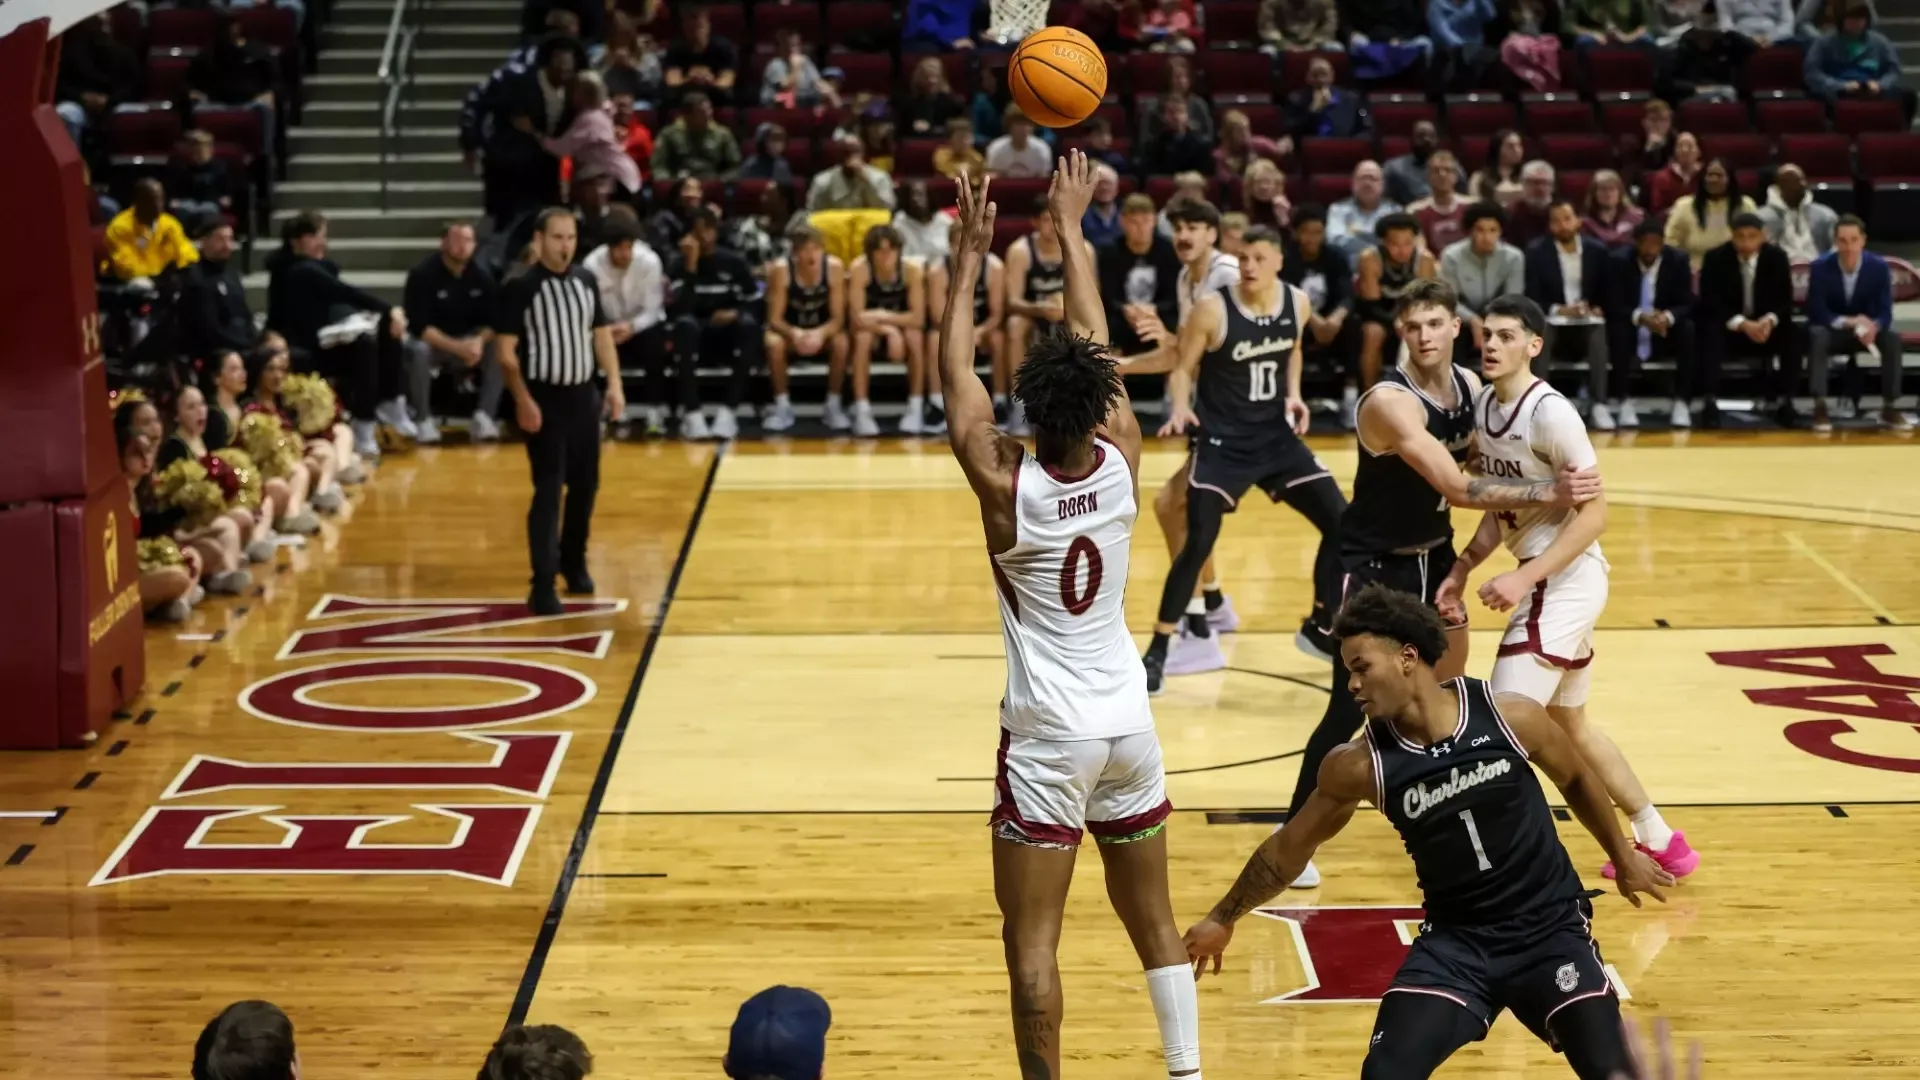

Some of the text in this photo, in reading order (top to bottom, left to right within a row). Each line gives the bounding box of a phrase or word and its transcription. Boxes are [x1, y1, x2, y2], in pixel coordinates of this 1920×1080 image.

[1249, 361, 1278, 401] 10
[1058, 491, 1098, 520] DORN
[1061, 535, 1103, 616] 0
[1705, 643, 1920, 774] CAA
[88, 593, 629, 887] ELON
[1471, 735, 1491, 746] CAA
[1403, 758, 1511, 819] Charleston
[1459, 809, 1493, 871] 1
